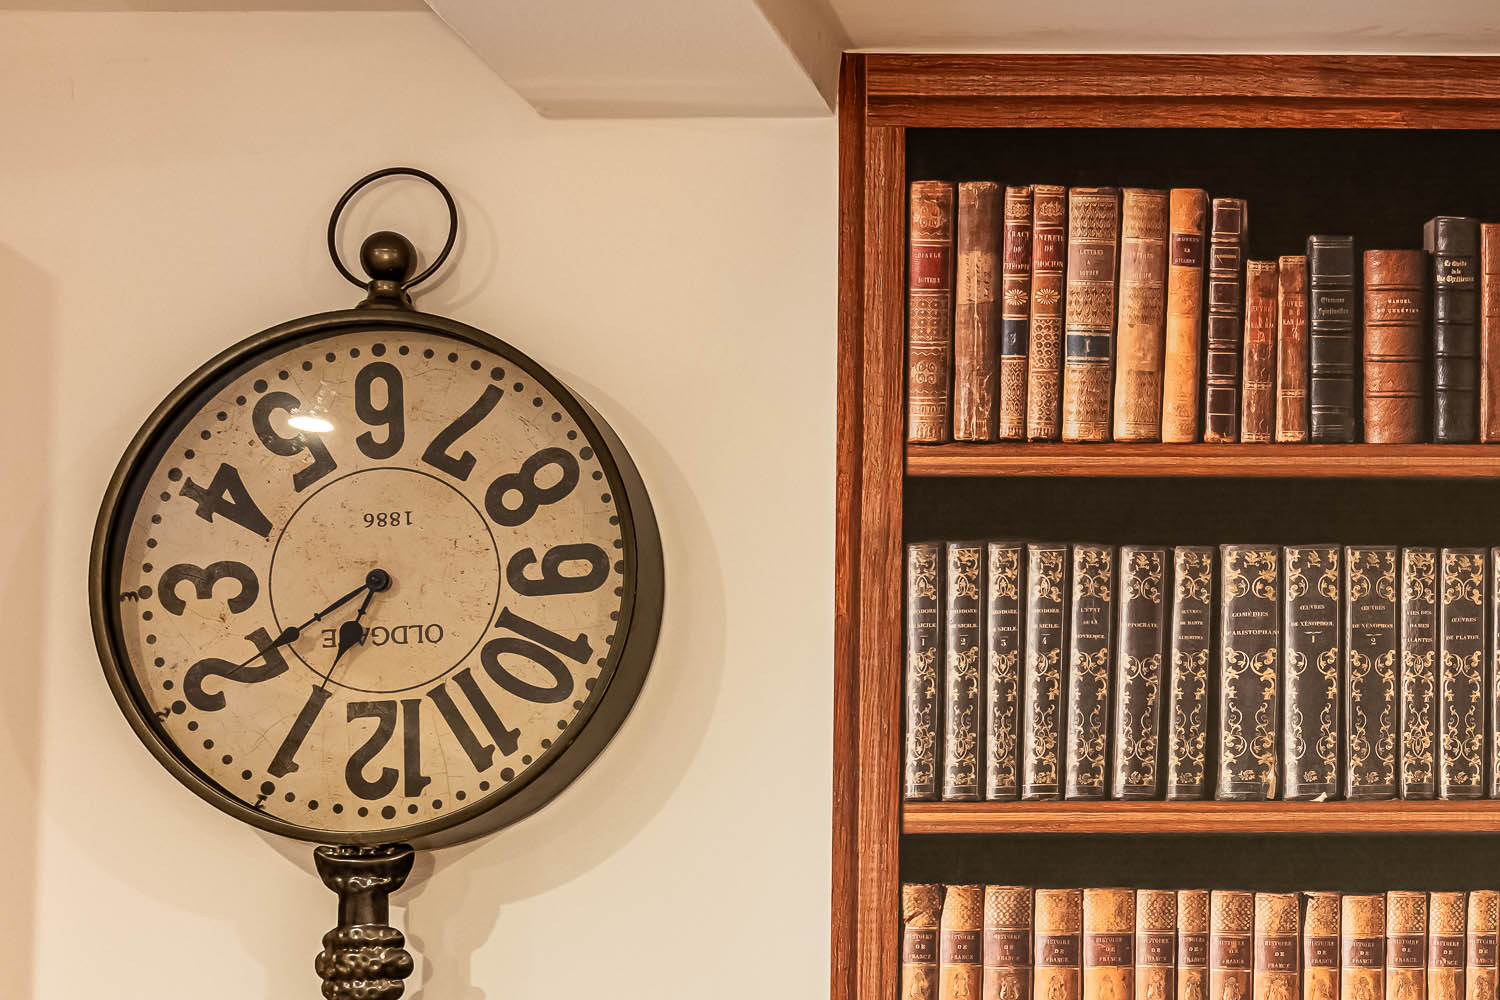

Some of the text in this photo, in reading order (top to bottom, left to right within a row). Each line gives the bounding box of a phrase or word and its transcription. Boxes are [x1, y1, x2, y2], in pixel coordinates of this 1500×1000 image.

[252, 391, 337, 492] 5
[421, 384, 504, 481] 7
[179, 463, 273, 538] 4
[362, 510, 413, 528] 1886
[484, 447, 580, 527] 8
[158, 561, 259, 615] 3
[506, 543, 610, 596] 9
[183, 627, 289, 712] 2
[321, 623, 444, 648] OLDGAE
[480, 606, 594, 703] 10
[268, 683, 332, 779] 1
[346, 700, 431, 800] 12
[427, 668, 521, 772] 11
